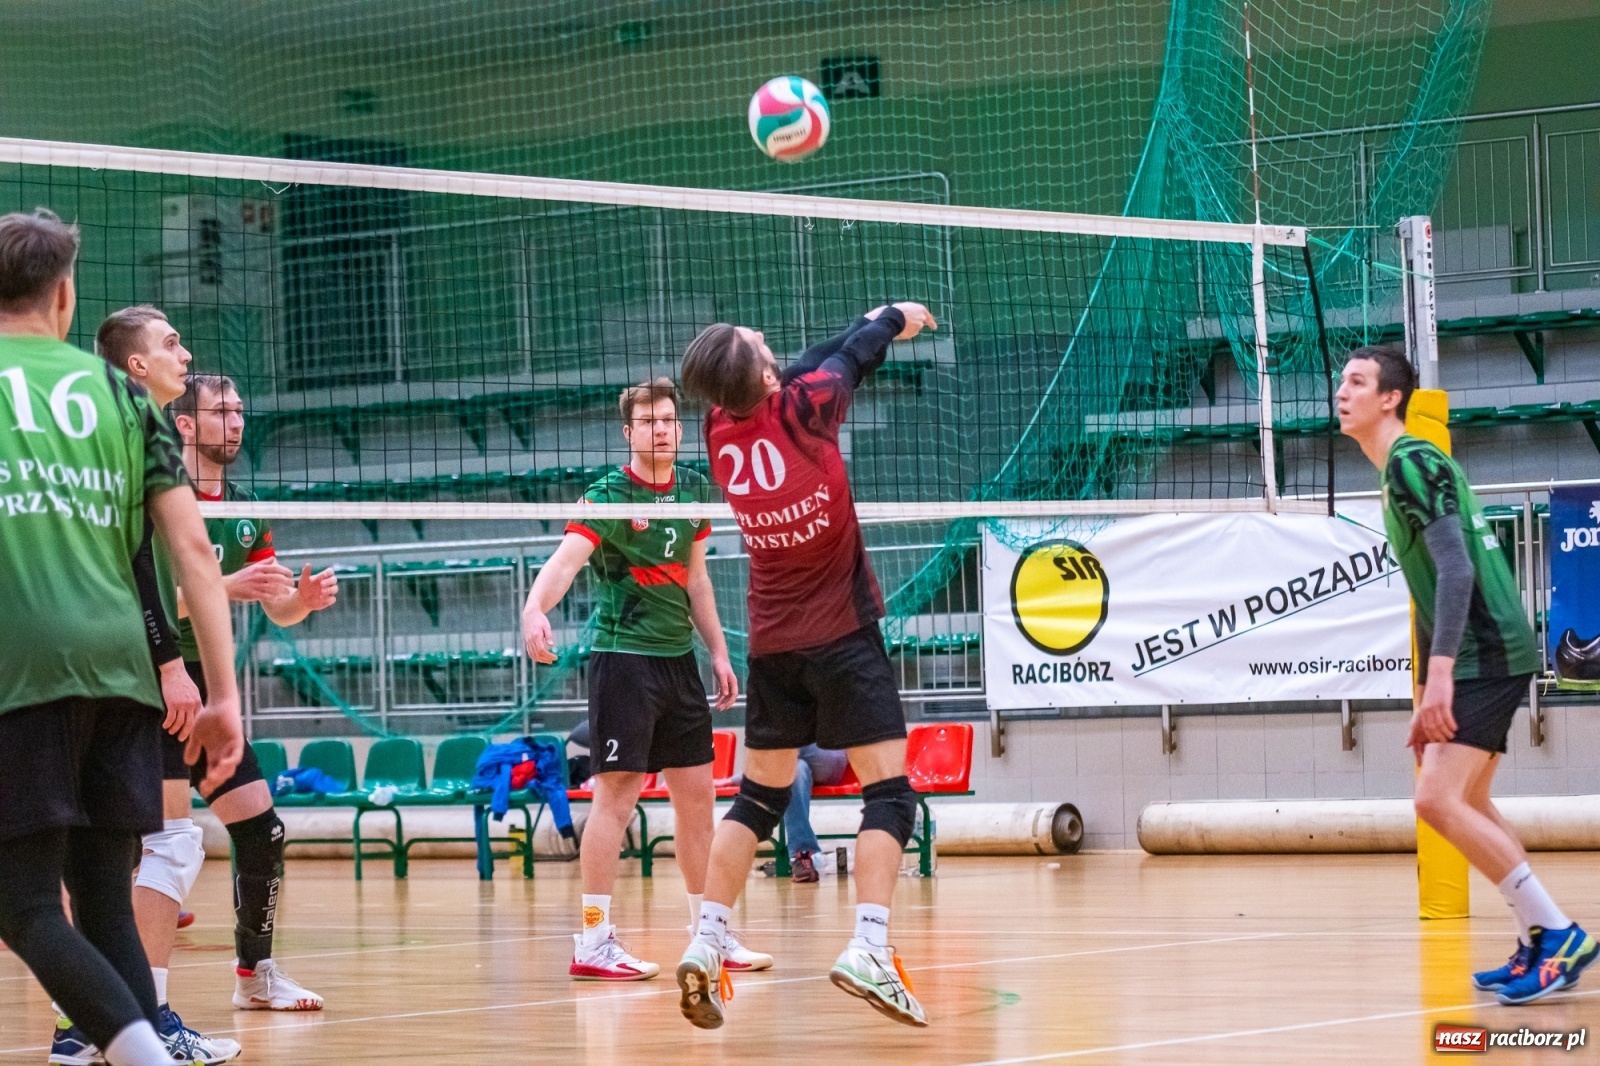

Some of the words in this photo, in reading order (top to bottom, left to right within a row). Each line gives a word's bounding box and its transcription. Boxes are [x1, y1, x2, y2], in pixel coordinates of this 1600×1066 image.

[0, 367, 98, 439] 16
[718, 438, 786, 496] 20
[664, 527, 677, 558] 2
[1131, 619, 1200, 672] JEST
[1207, 604, 1237, 639] W
[1244, 540, 1400, 626] PORZĄDK
[143, 609, 162, 646] KIPSTA
[1012, 656, 1114, 685] RACIBÓRZ
[605, 739, 619, 762] 2
